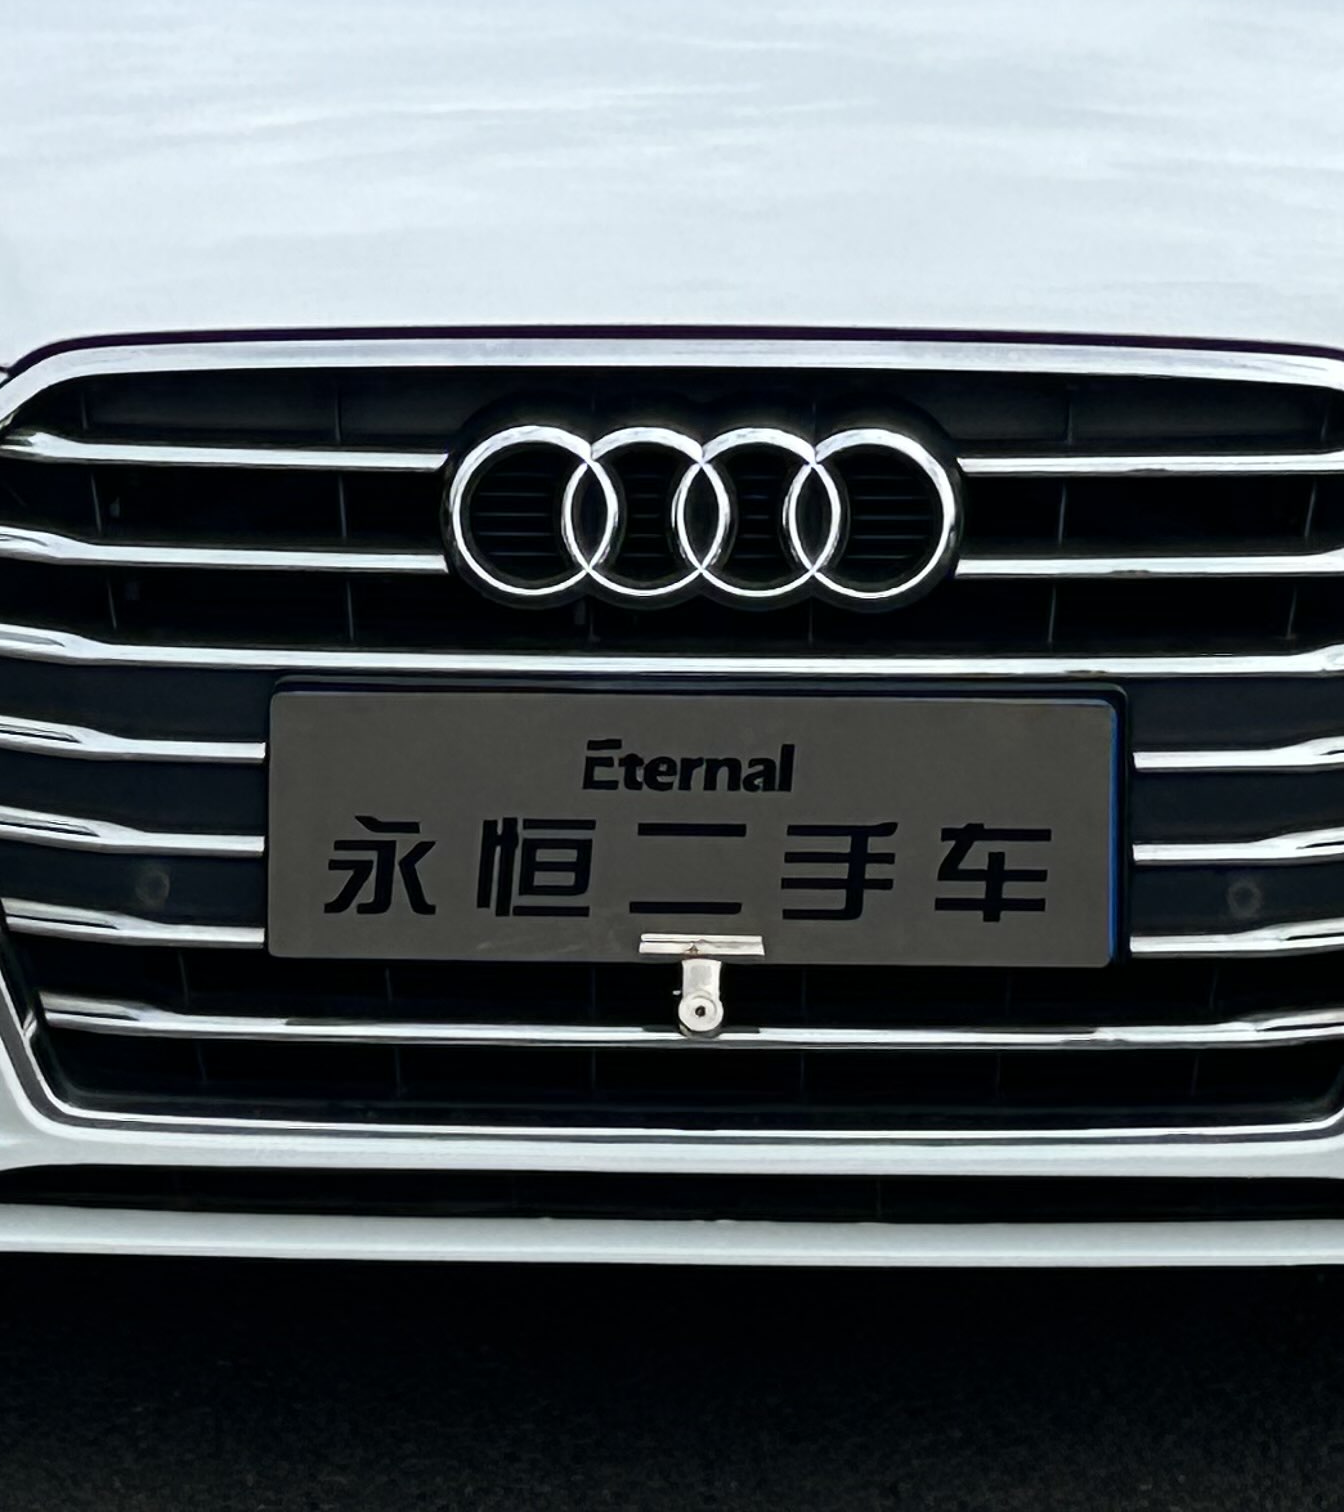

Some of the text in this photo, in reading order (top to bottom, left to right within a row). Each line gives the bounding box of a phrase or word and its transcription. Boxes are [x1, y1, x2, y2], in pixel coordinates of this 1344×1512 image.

[582, 738, 795, 794] Eternal
[323, 814, 1054, 923] 永恒二手车
